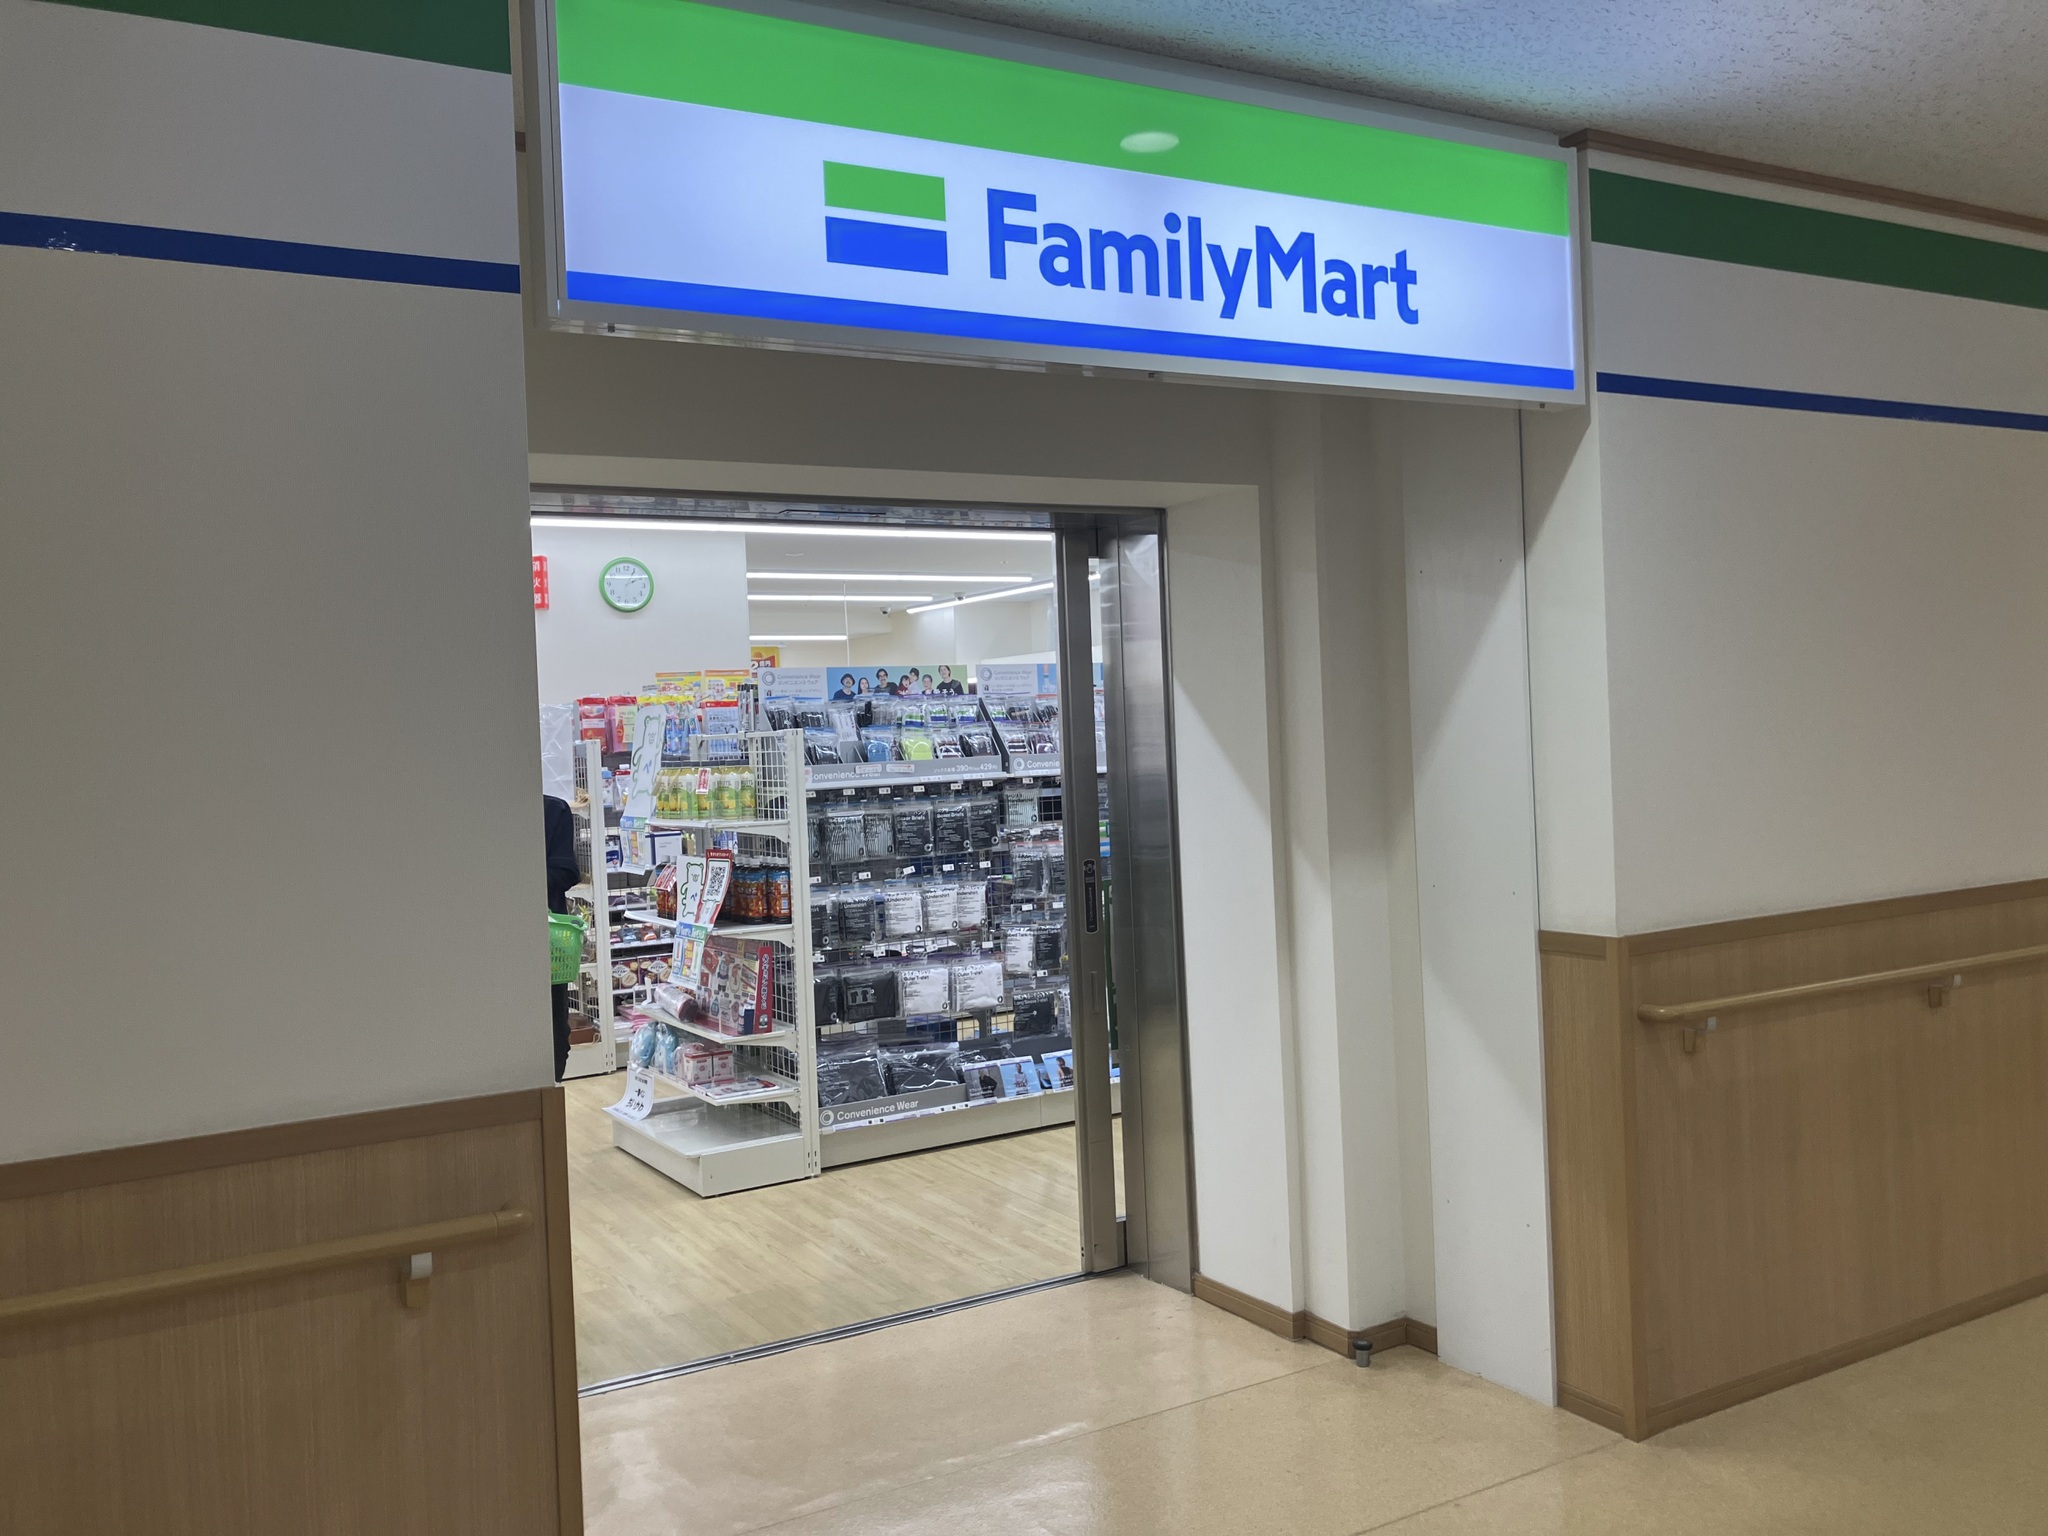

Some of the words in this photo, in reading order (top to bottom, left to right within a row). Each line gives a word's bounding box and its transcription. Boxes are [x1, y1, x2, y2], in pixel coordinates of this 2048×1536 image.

[986, 187, 1419, 326] FamilyMart
[836, 1104, 896, 1121] Convenience
[896, 1099, 919, 1112] Wear
